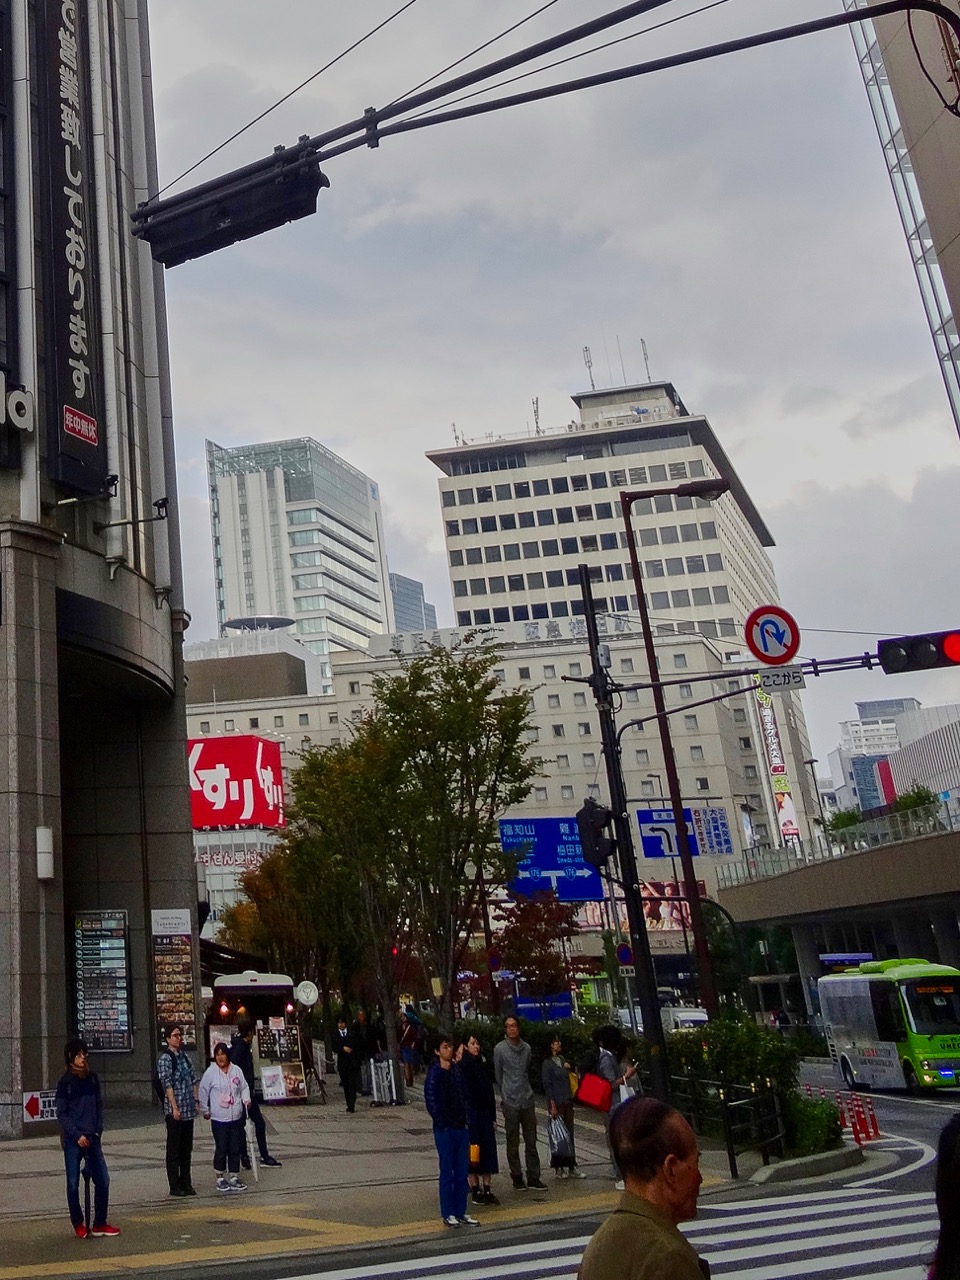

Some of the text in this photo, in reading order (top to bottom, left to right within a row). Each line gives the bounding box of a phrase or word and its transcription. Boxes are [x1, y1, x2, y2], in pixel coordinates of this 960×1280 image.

[64, 410, 97, 440] 年中無休
[762, 672, 802, 687] ここから
[189, 743, 254, 820] くすり
